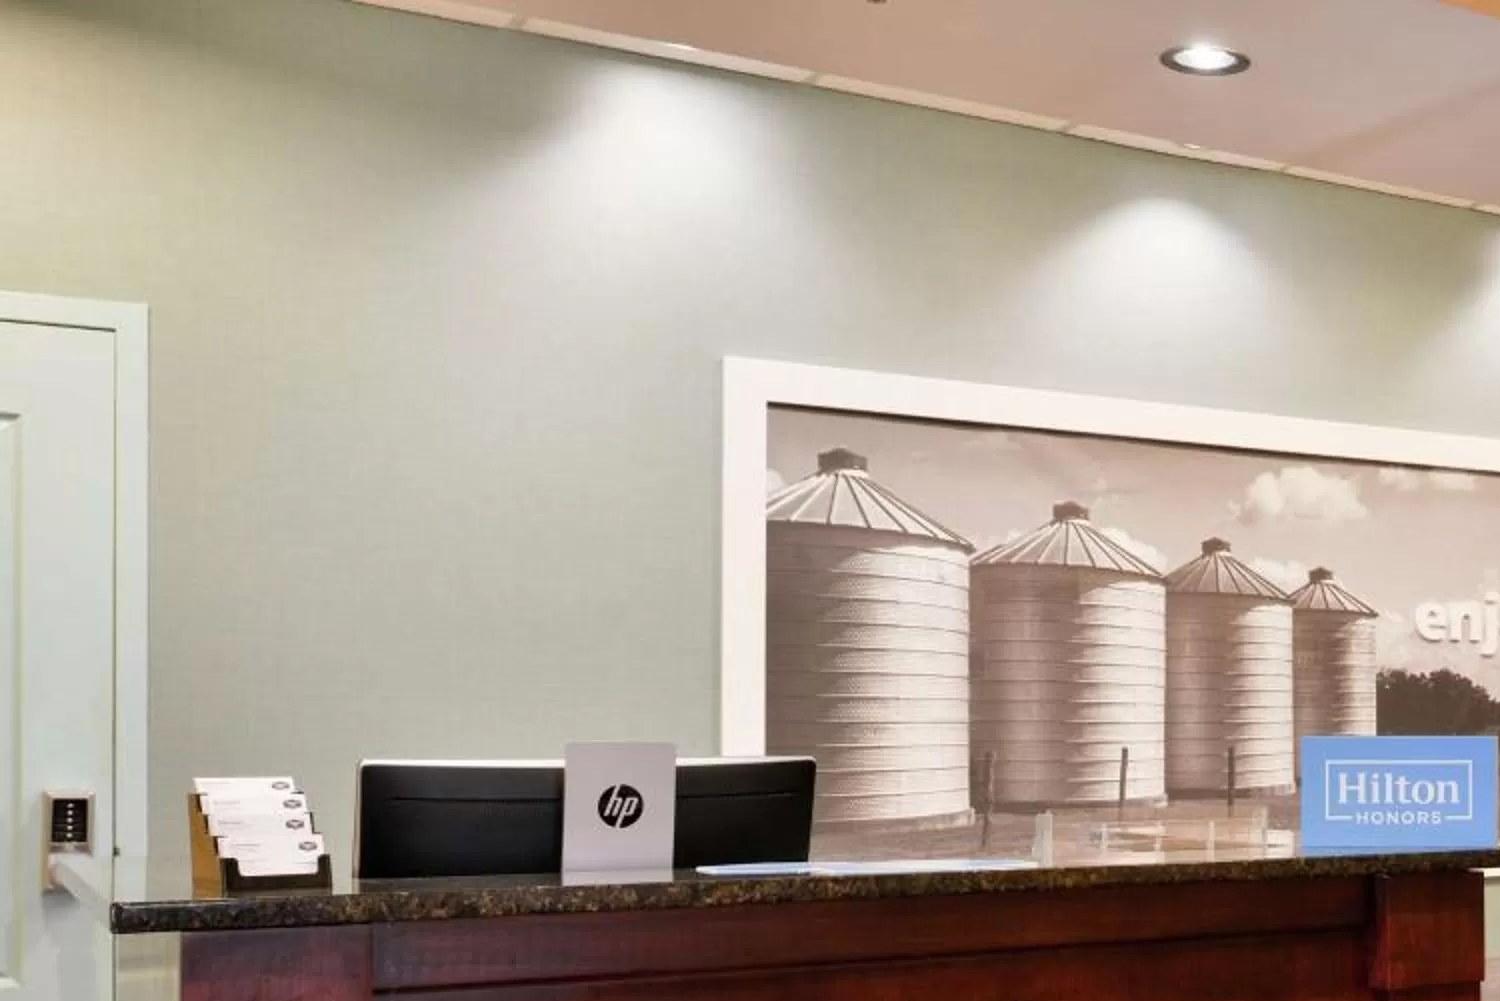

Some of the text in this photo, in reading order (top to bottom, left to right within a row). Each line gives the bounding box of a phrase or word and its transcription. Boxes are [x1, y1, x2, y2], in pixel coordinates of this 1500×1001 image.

[1338, 772, 1461, 805] Hilton
[602, 783, 641, 829] hp
[1356, 811, 1442, 825] HONORS
